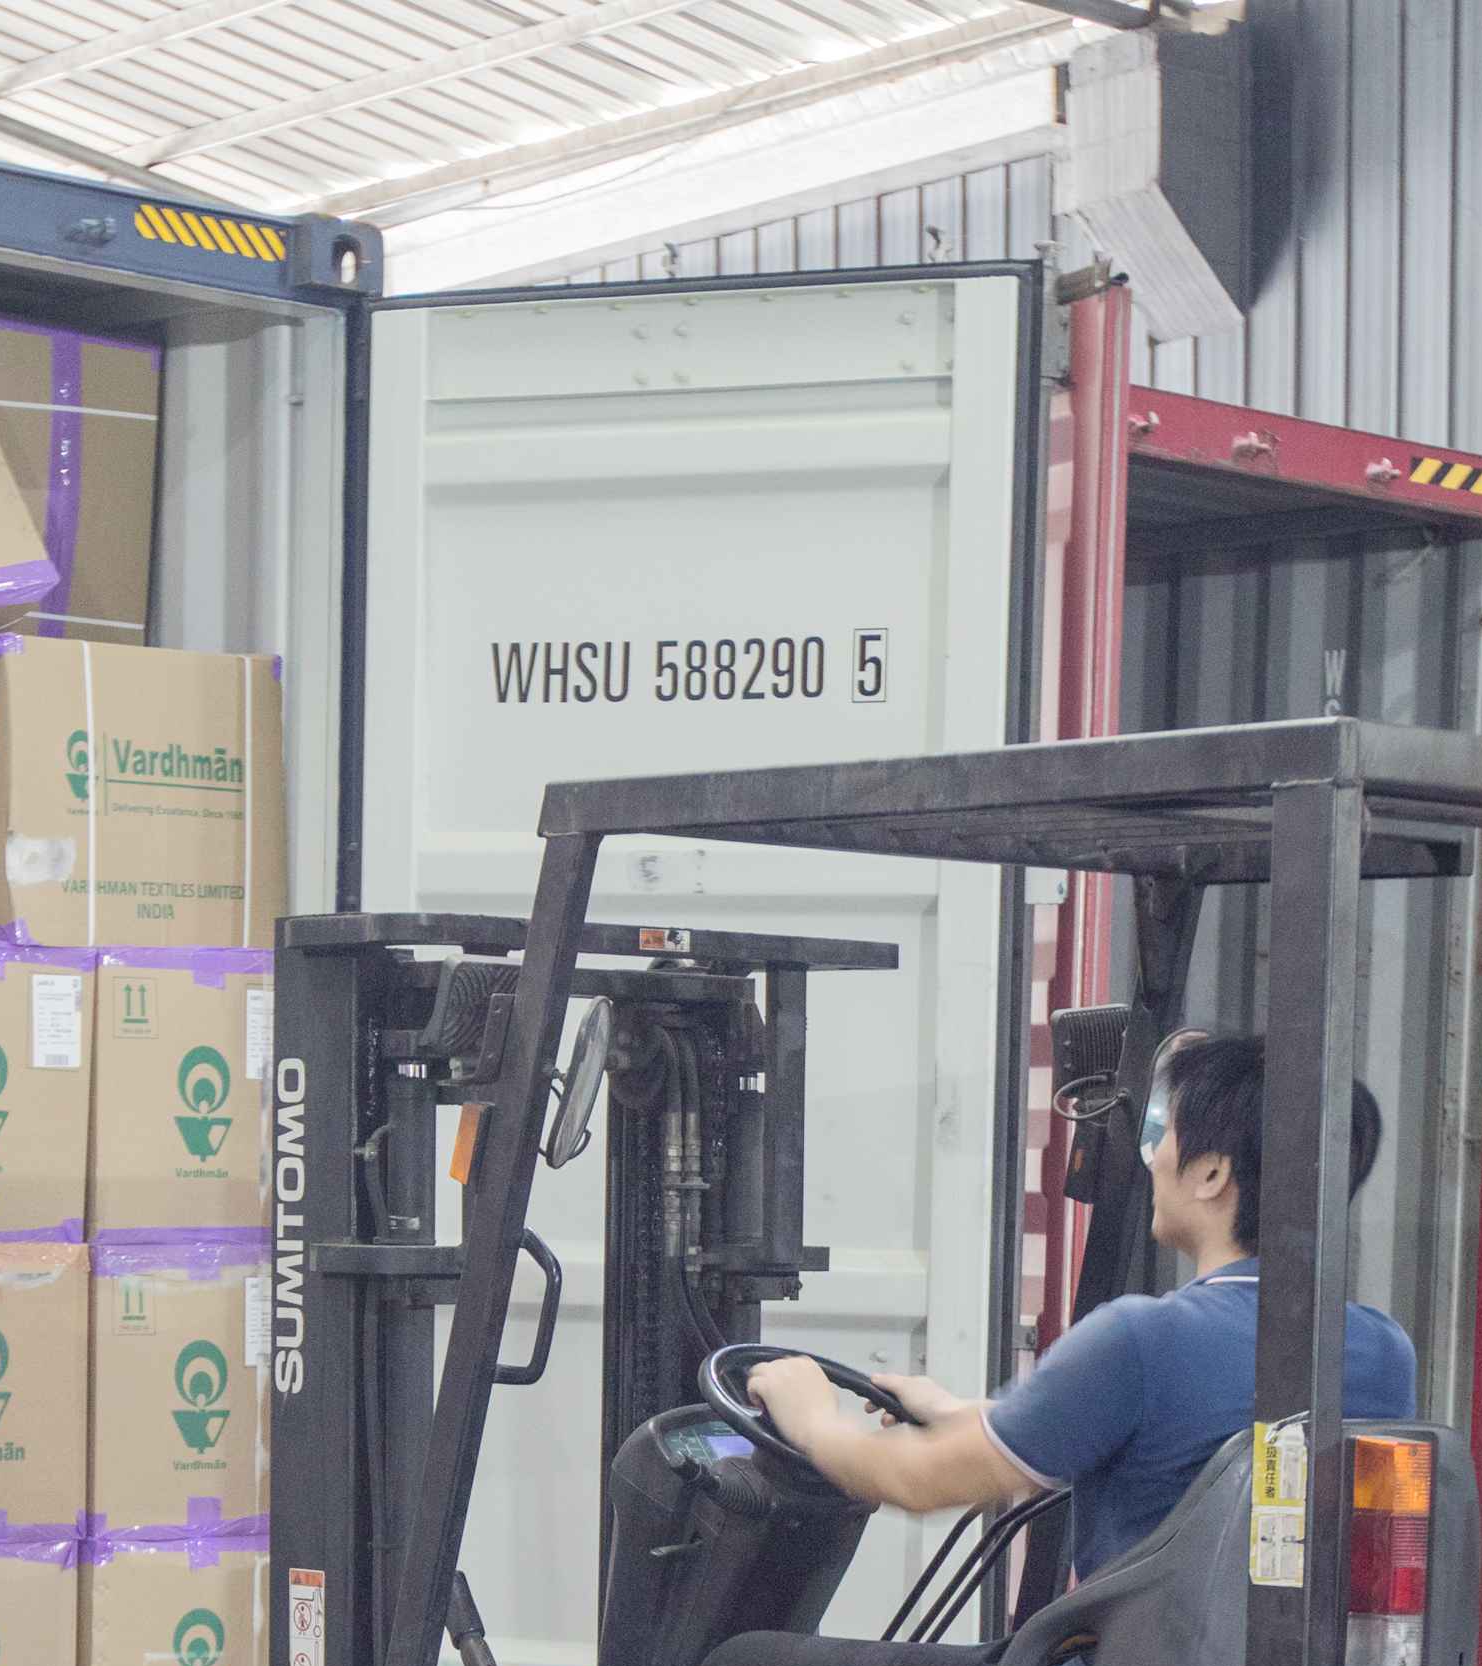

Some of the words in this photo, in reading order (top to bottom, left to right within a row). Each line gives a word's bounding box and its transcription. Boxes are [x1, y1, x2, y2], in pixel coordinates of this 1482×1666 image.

[491, 641, 630, 703] WHSU
[655, 636, 824, 701] 588290
[857, 634, 882, 698] 5
[113, 738, 243, 784] Vardhmān
[61, 879, 137, 897] VARHMAN
[141, 881, 196, 898] TEXTILES
[197, 884, 245, 900] LIMITED
[136, 902, 175, 920] INDIA
[275, 1057, 306, 1395] SUMITOMO
